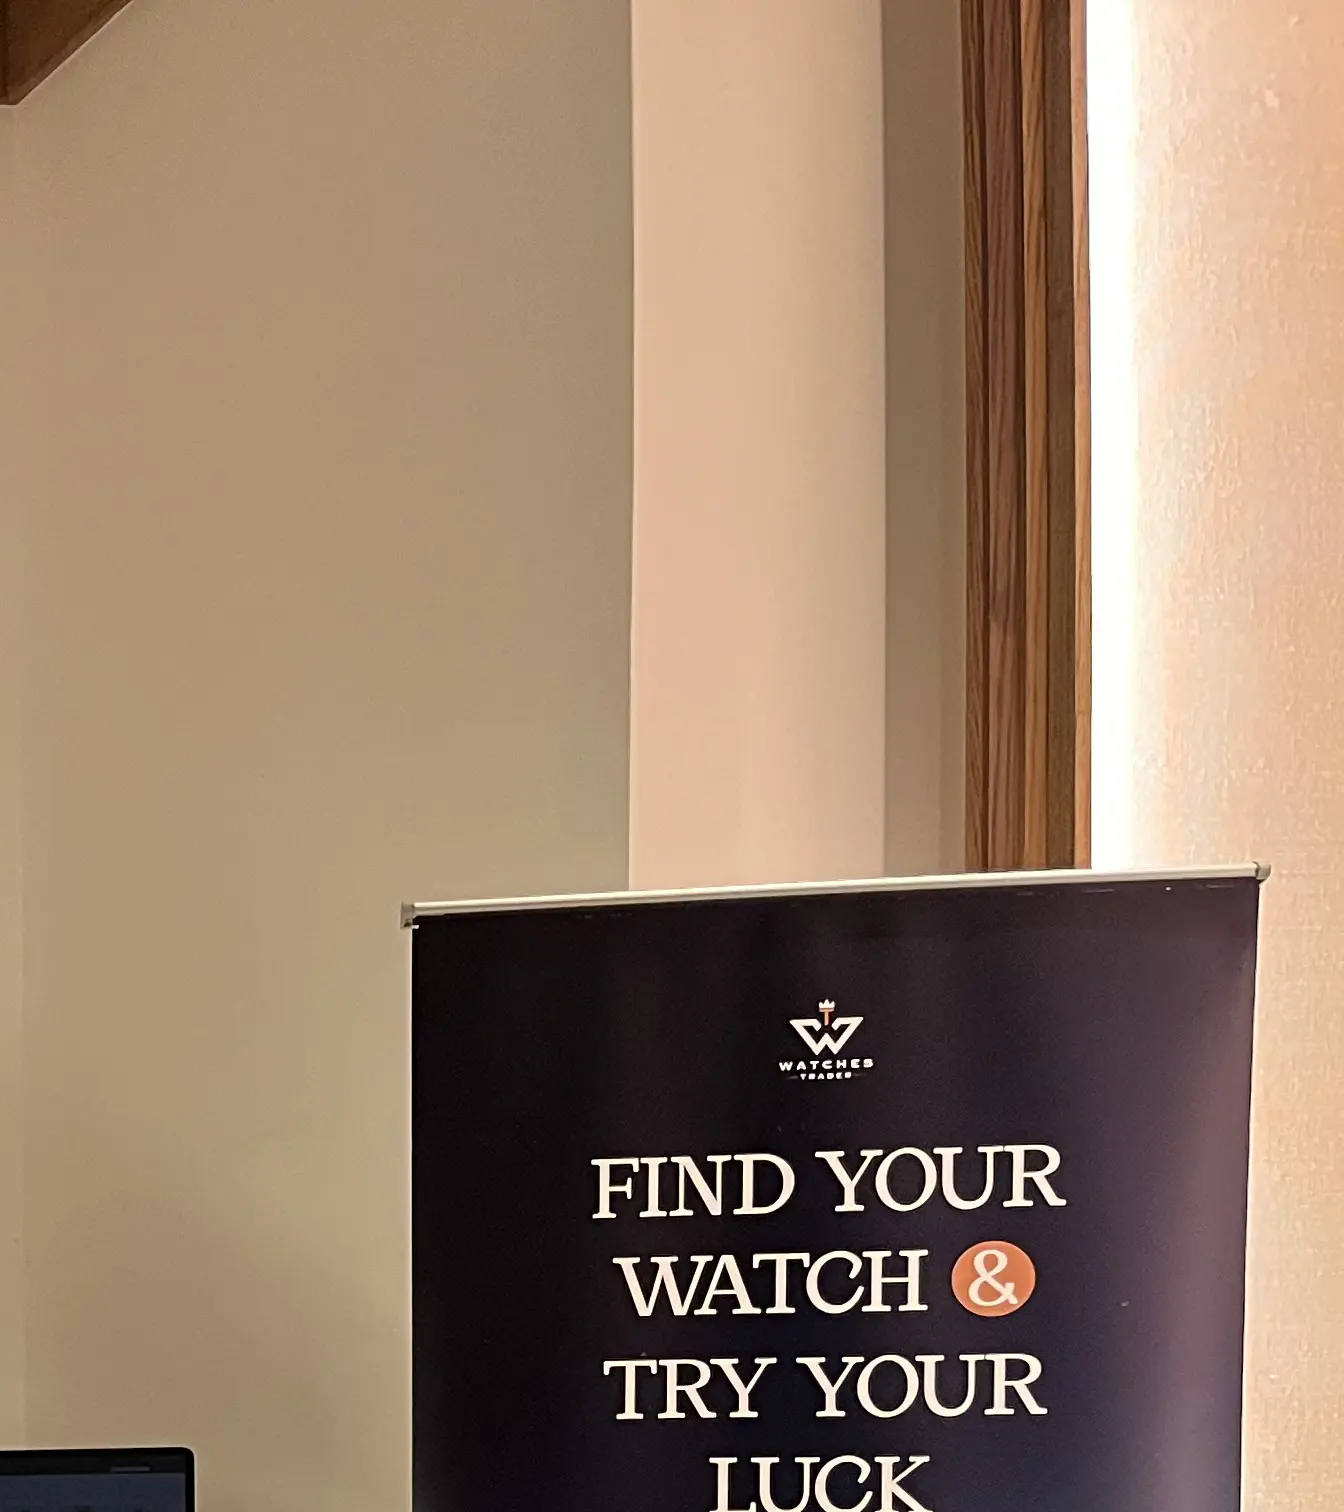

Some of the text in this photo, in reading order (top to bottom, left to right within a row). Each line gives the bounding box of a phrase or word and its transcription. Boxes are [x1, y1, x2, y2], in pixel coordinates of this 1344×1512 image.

[778, 1058, 874, 1071] WATCHES
[800, 1071, 852, 1080] TRADER
[591, 1143, 1067, 1219] FIND YOUR
[612, 1249, 1019, 1317] WATCH &
[603, 1353, 1048, 1420] TRY YOUR
